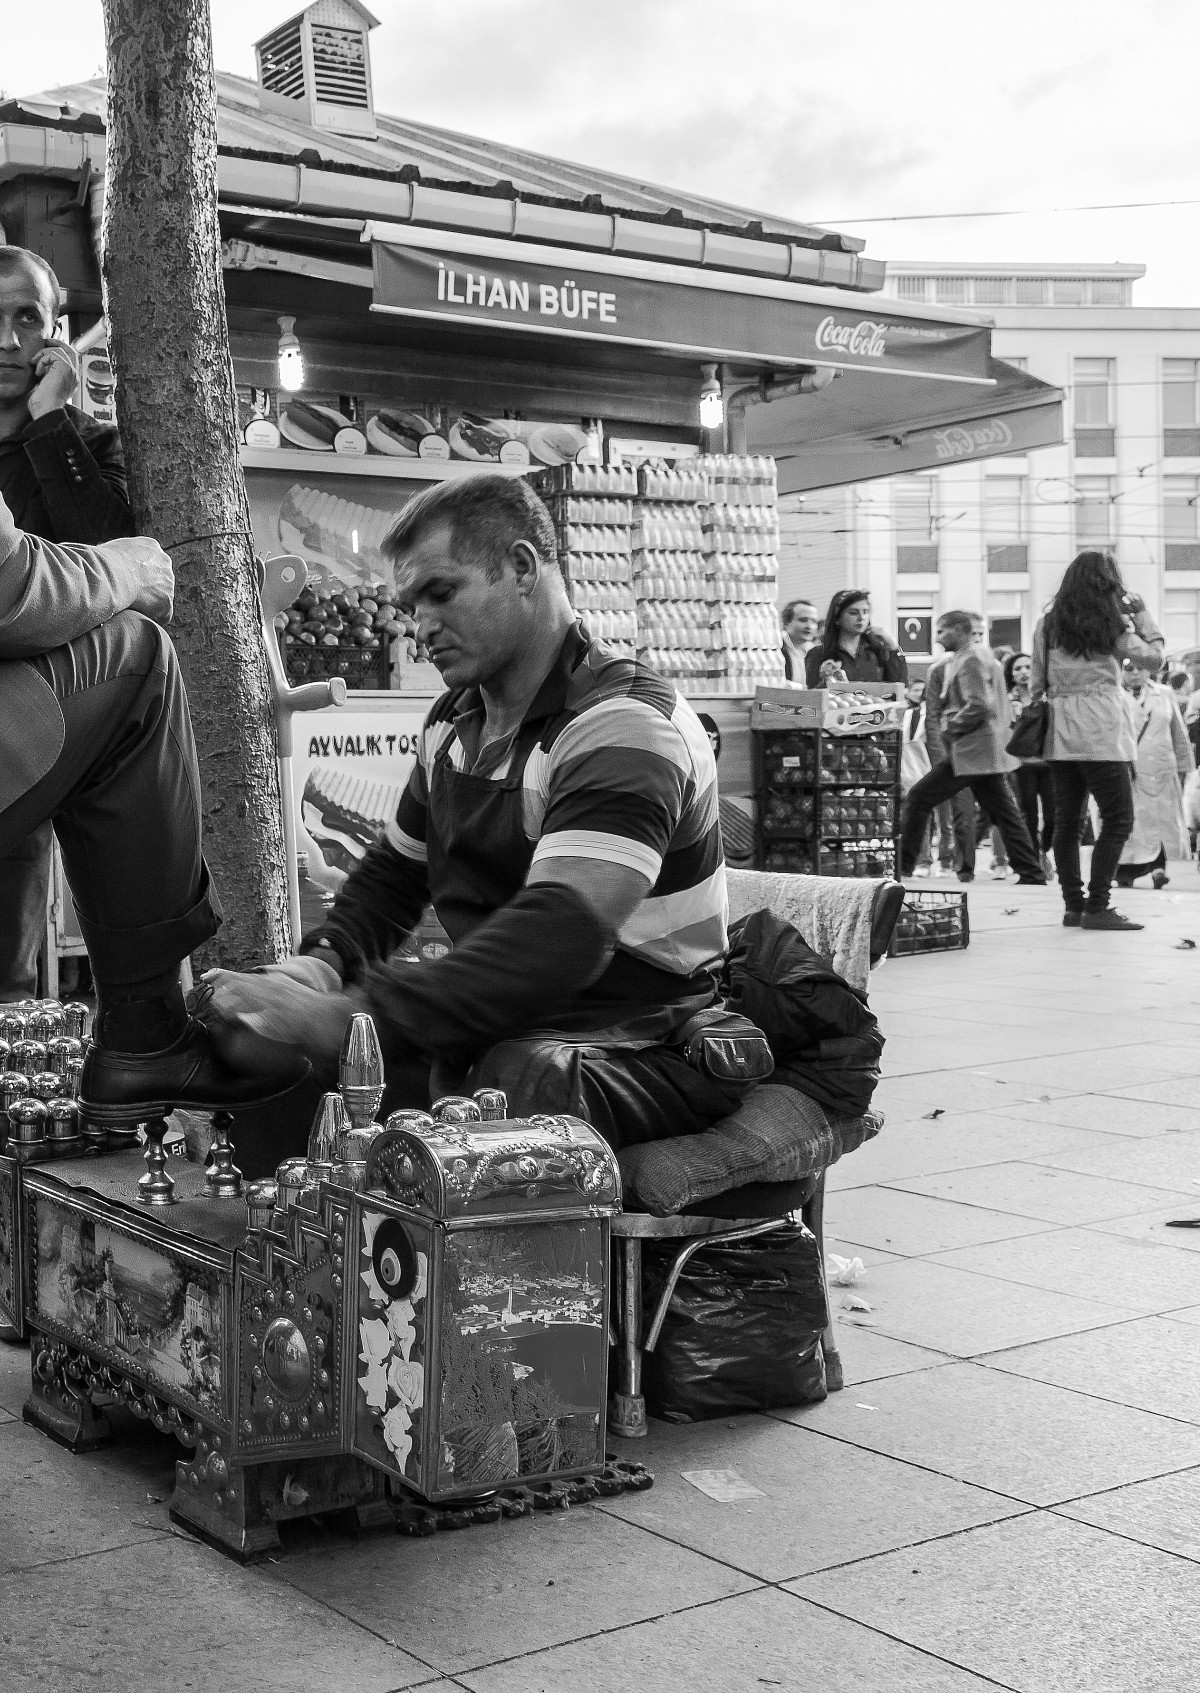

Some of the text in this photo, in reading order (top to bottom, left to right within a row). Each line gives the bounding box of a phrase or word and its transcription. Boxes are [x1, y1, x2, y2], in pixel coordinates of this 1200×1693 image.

[437, 261, 618, 324] İLHAN BÜFE
[308, 735, 382, 758] AYVALIK
